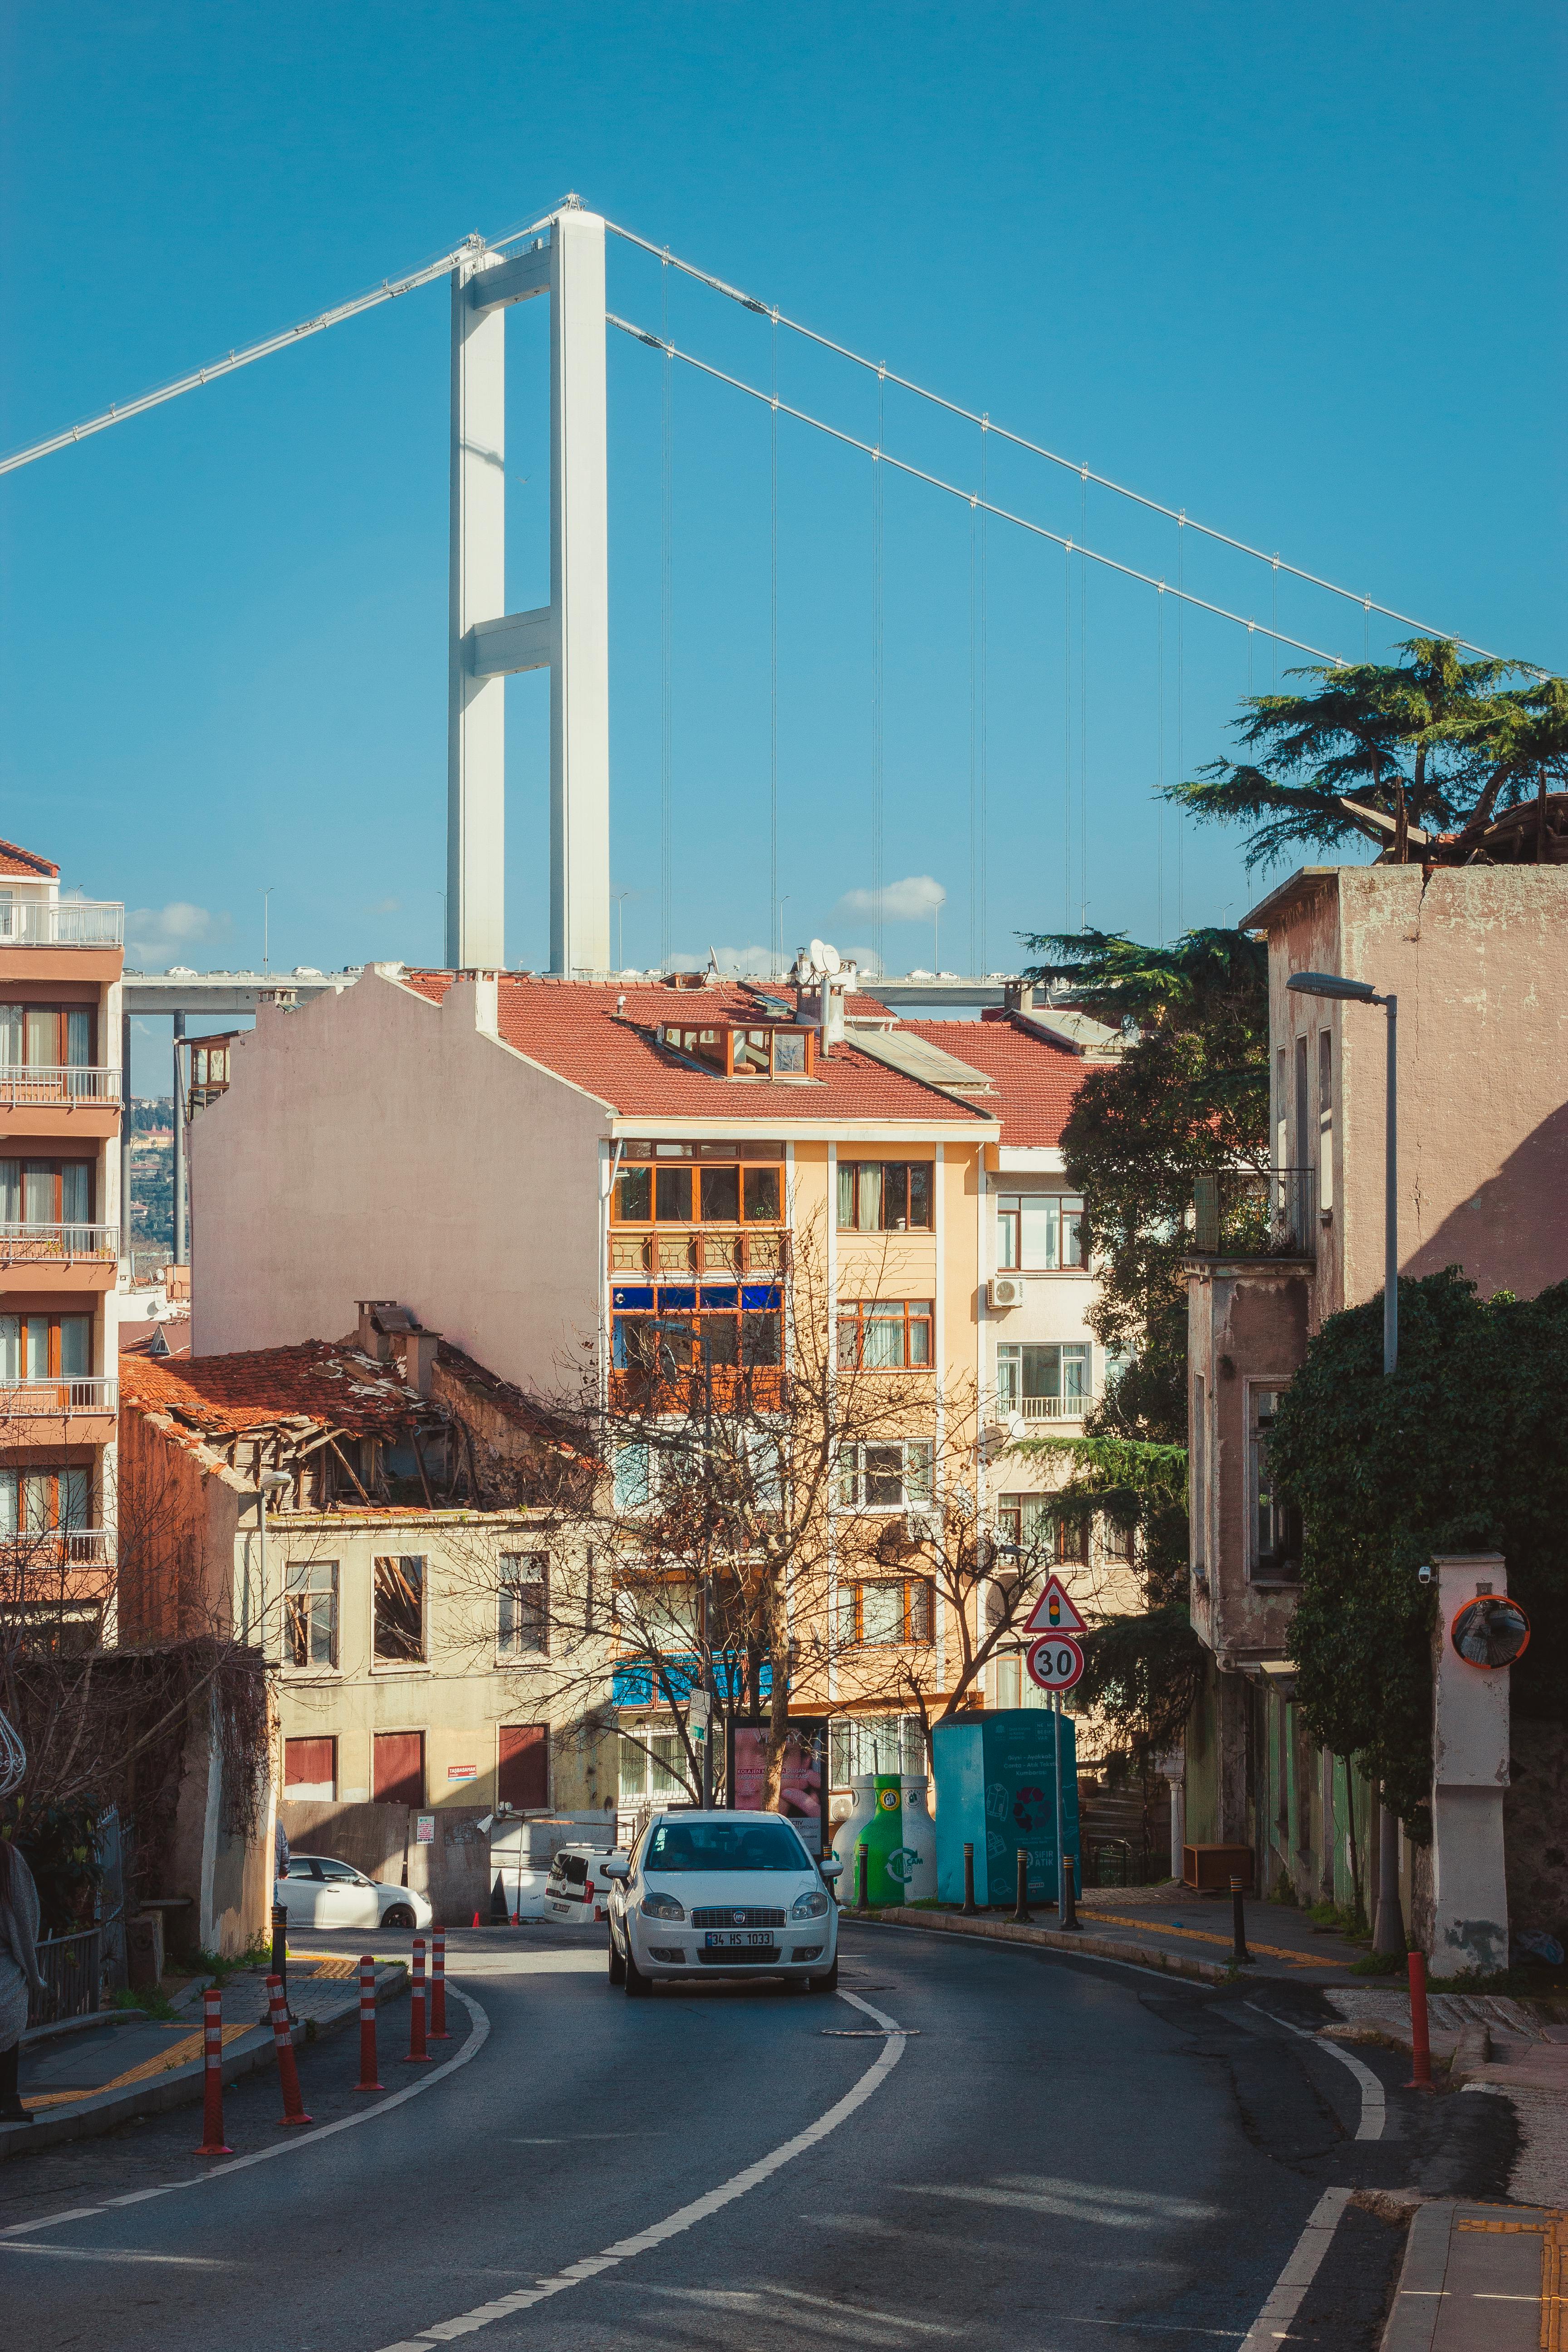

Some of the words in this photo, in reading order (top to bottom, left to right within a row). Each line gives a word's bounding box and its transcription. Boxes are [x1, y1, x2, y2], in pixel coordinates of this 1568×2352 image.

[1038, 1650, 1072, 1676] 30
[712, 1934, 724, 1945] 34
[730, 1934, 741, 1945] HS
[747, 1933, 770, 1945] 1033
